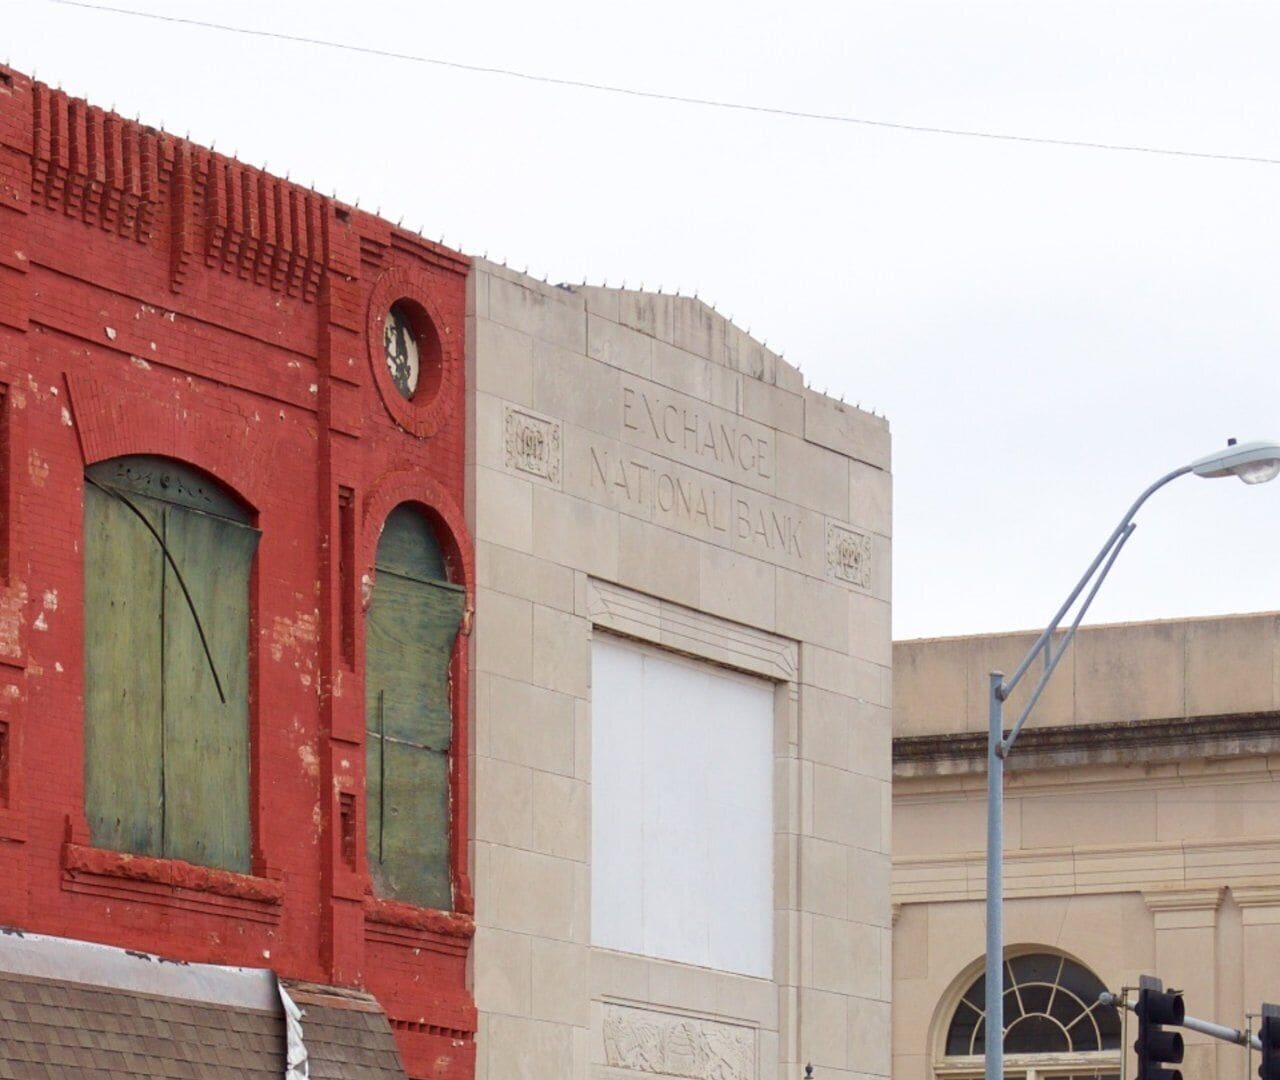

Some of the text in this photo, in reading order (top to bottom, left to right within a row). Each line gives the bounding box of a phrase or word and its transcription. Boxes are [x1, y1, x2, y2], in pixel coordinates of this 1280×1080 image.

[623, 387, 771, 479] EXCHANGE
[589, 446, 805, 559] NATIONAL BANK
